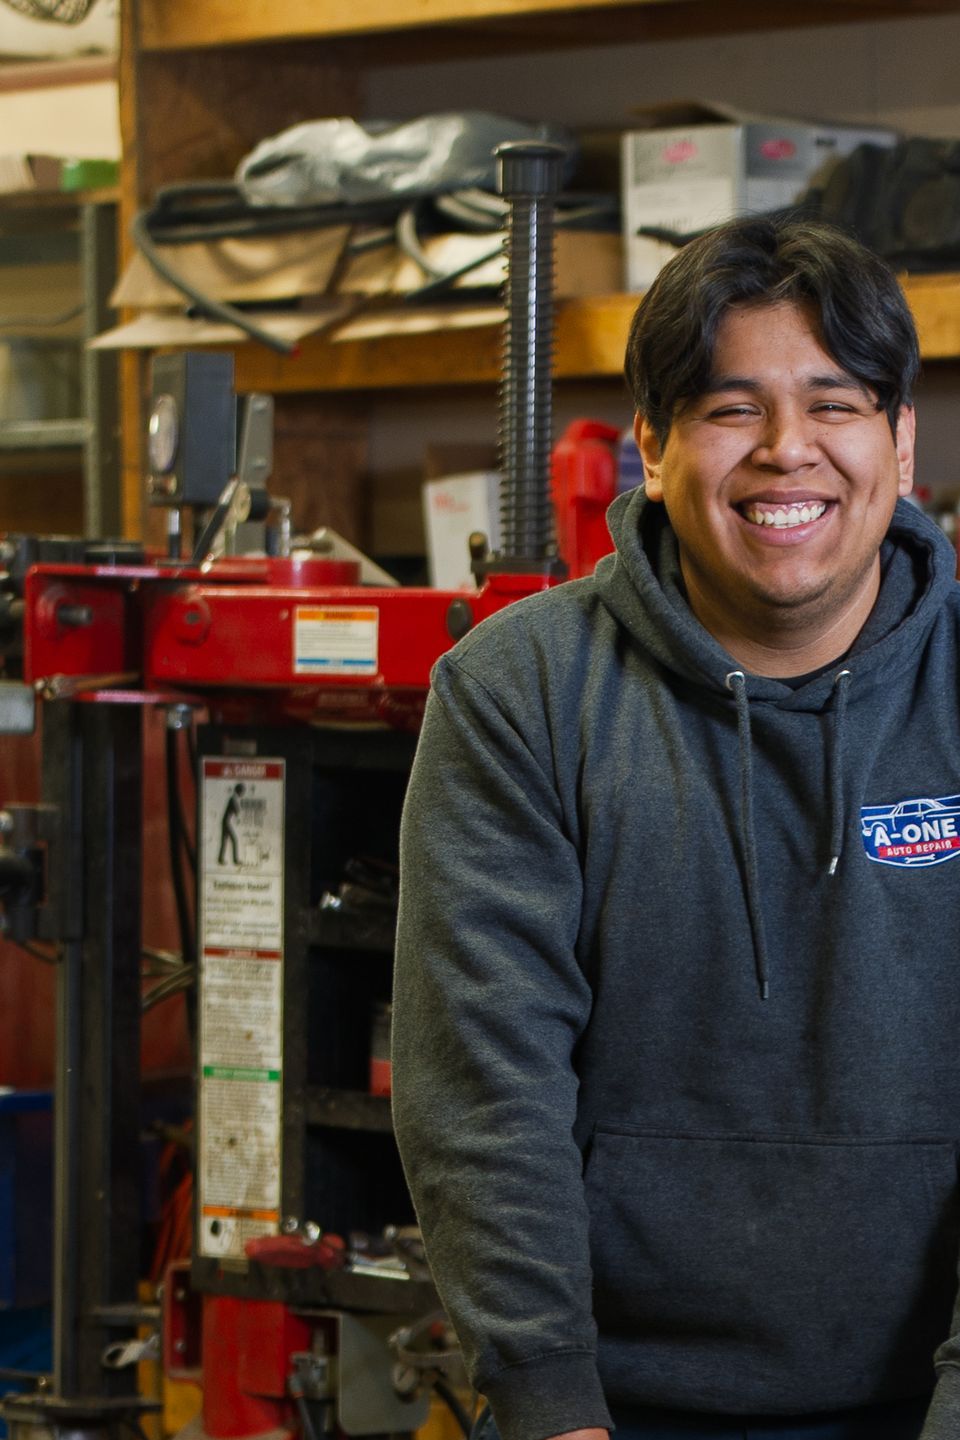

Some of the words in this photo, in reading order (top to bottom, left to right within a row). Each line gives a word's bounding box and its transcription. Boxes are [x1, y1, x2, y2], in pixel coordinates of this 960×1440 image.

[874, 818, 959, 847] A-ONE
[887, 846, 913, 857] AUTO
[916, 840, 952, 854] REPAIR
